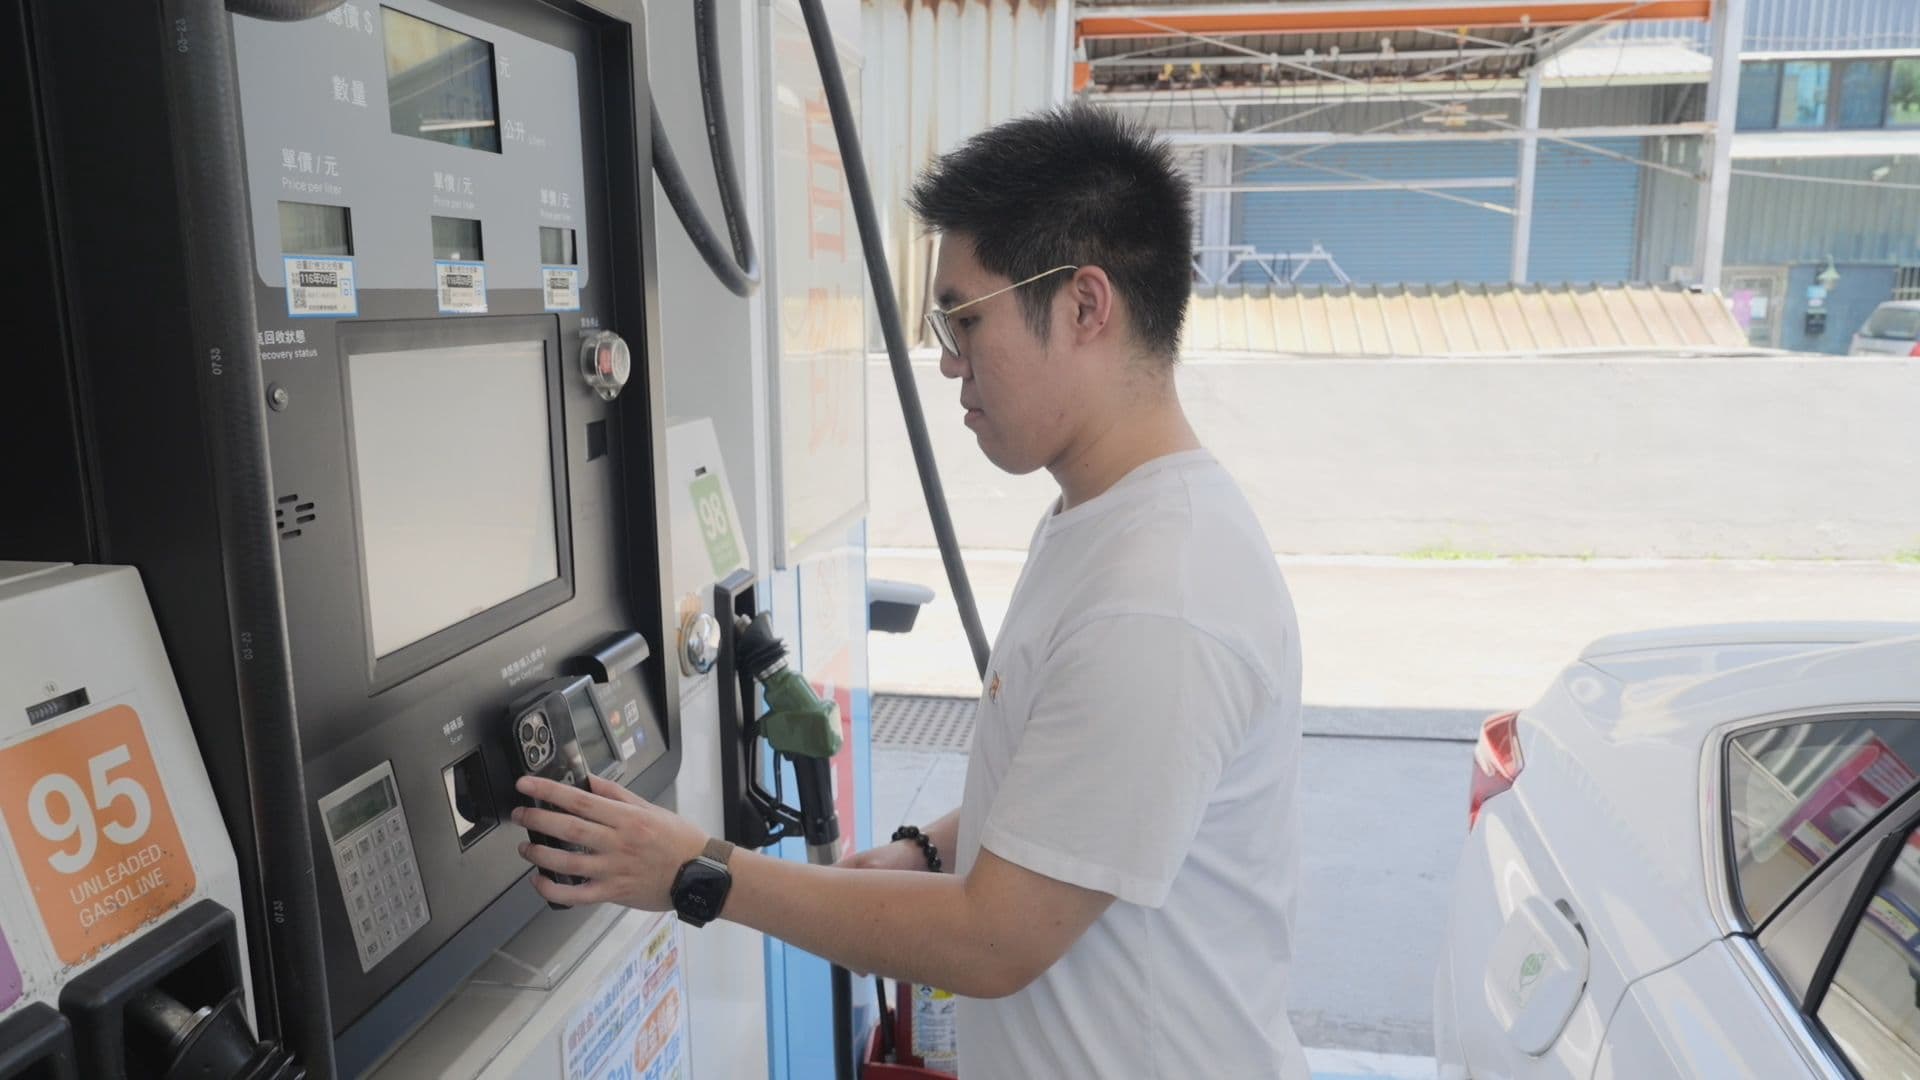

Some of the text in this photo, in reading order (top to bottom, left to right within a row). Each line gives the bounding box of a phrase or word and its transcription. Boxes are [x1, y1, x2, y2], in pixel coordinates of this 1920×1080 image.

[500, 56, 512, 79] 元
[332, 75, 367, 108] 數量
[504, 119, 526, 141] 公升
[281, 177, 307, 193] Price
[308, 182, 322, 194] per
[294, 349, 318, 359] status
[698, 493, 728, 541] 98
[27, 743, 153, 874] 95
[69, 844, 163, 905] UNLEADED
[79, 867, 166, 928] GASOLINE
